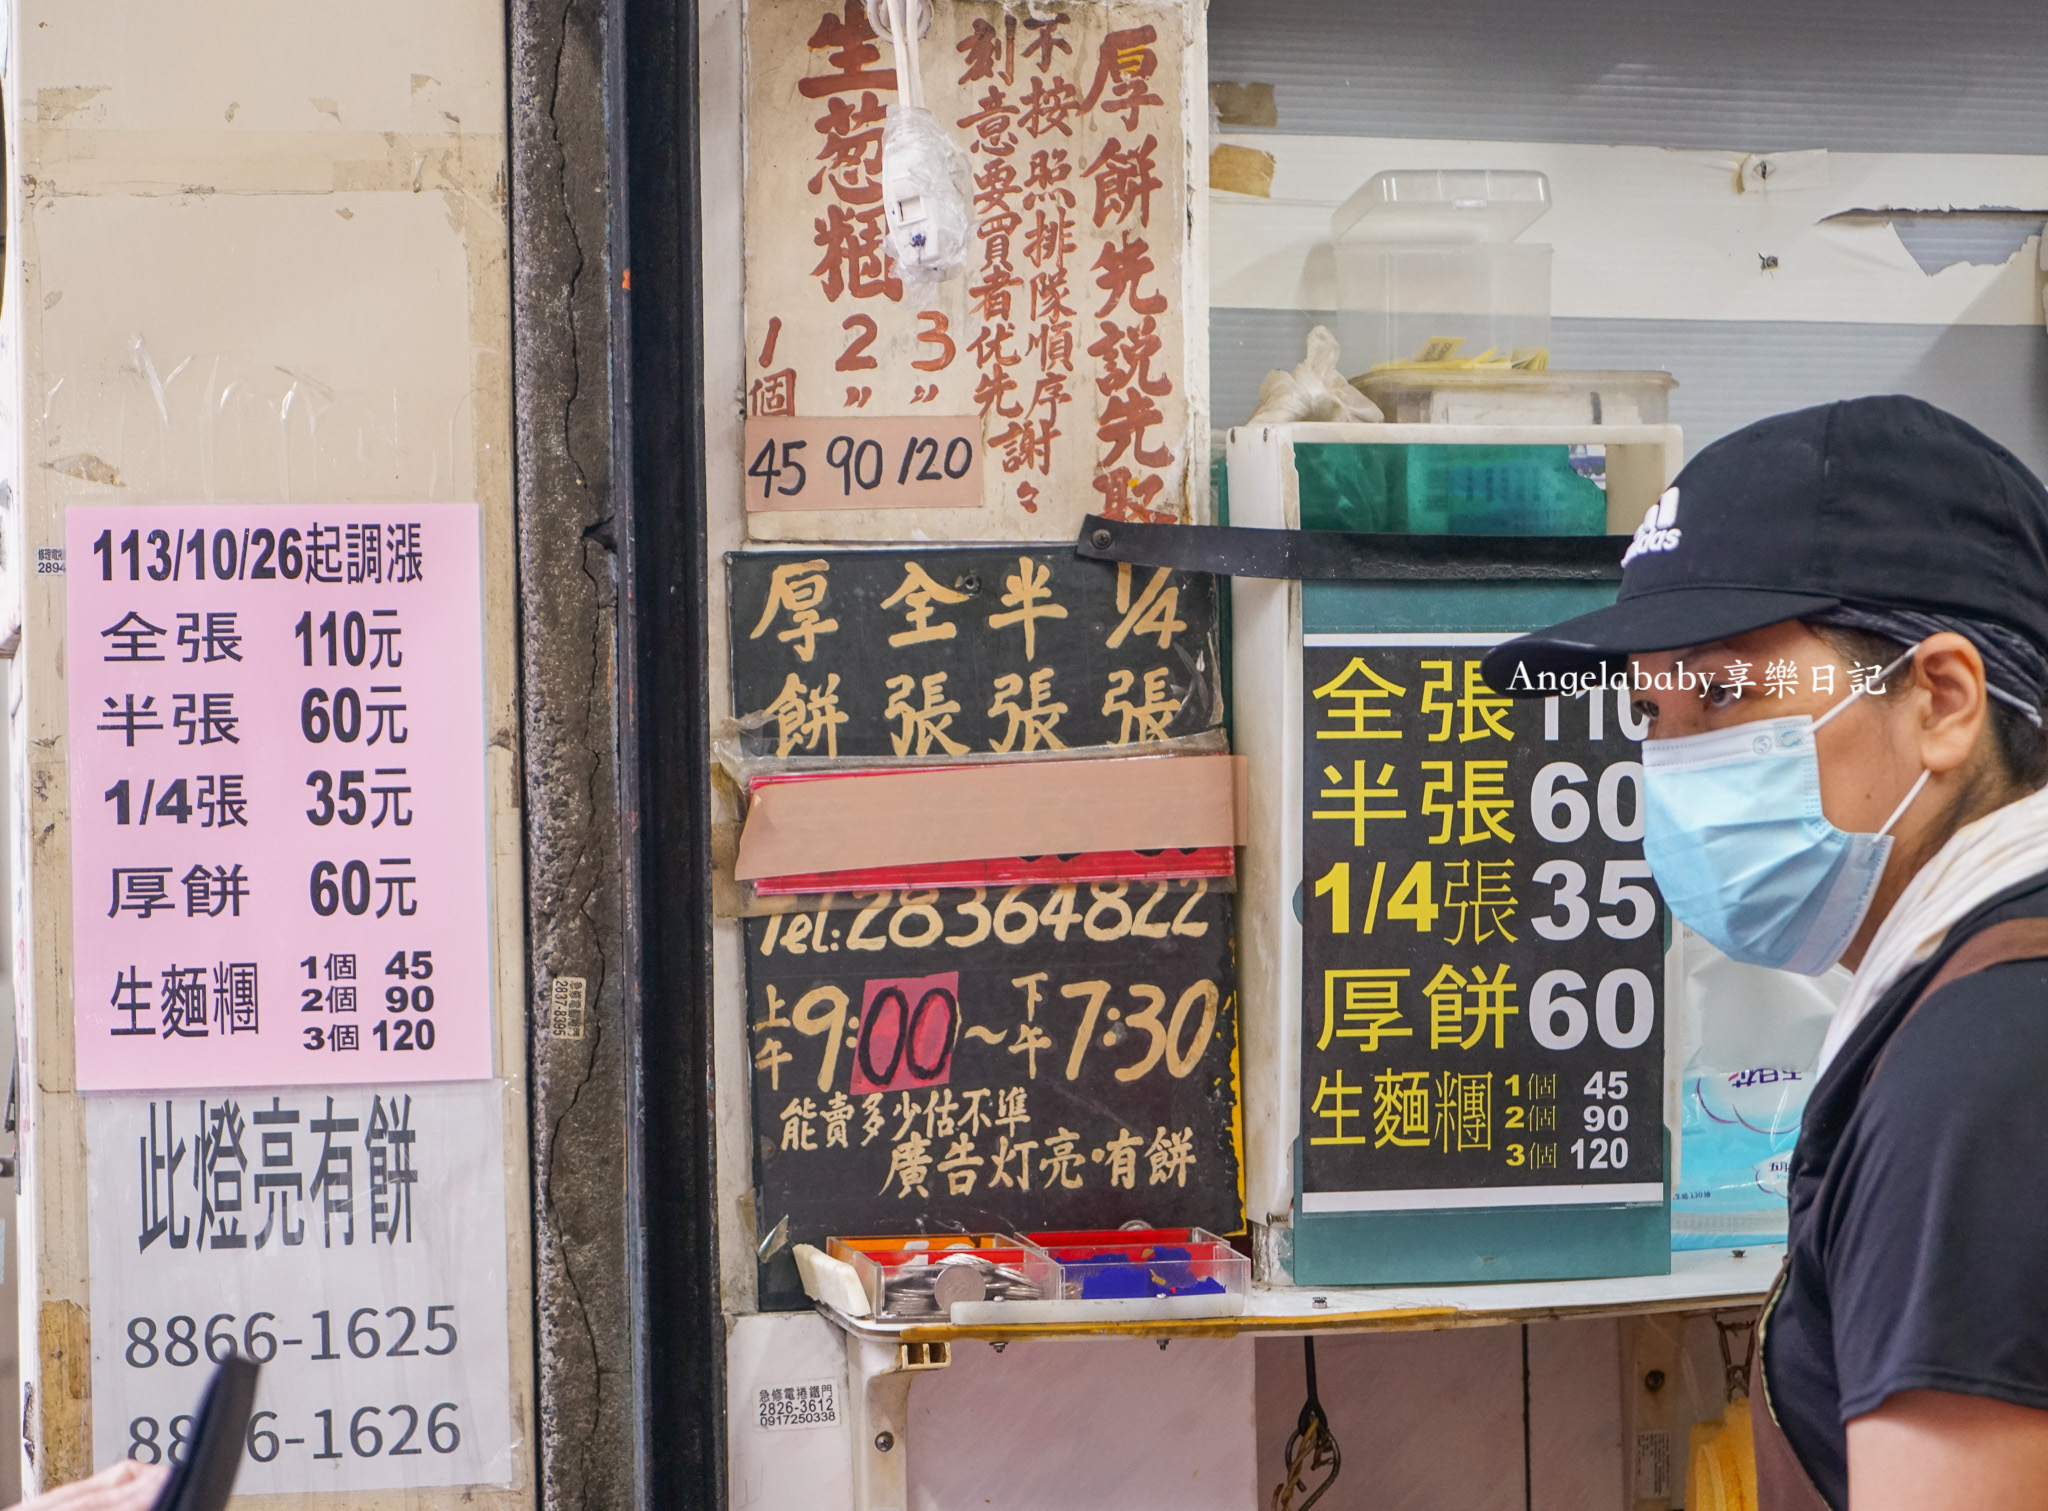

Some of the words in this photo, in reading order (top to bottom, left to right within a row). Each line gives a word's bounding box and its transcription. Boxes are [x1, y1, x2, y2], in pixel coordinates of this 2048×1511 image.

[748, 438, 807, 498] 45
[826, 436, 883, 495] 90
[897, 437, 972, 485] 120
[93, 521, 423, 585] 113/10/26起調漲
[101, 611, 244, 663] 全張
[295, 609, 402, 670] 110元
[750, 559, 849, 758] 厚餅
[881, 561, 970, 756] 全張
[97, 692, 241, 747] 半張
[301, 685, 408, 746] 60元
[1312, 657, 1515, 743] 全張
[104, 774, 248, 828] 1/4張
[305, 768, 413, 829] 35元
[1312, 760, 1515, 846] 半張
[1531, 761, 1645, 843] 60
[107, 864, 250, 918] 厚餅
[309, 857, 417, 918] 60元
[1313, 858, 1519, 946] 1/4張
[1530, 859, 1656, 941] 35
[300, 953, 357, 981] 1個
[385, 951, 433, 978] 45
[110, 961, 259, 1040] 生麵糰
[301, 985, 358, 1013] 2個
[385, 985, 434, 1012] 90
[553, 981, 568, 1036] 2837-8395
[1316, 963, 1518, 1052] 厚餅
[1528, 968, 1655, 1050] 60
[303, 1023, 360, 1051] 3個
[373, 1019, 435, 1051] 120
[1310, 1068, 1492, 1153] 生麵糰
[1504, 1105, 1556, 1132] 2個
[1583, 1104, 1629, 1133] 90
[1504, 1073, 1556, 1100] 1個
[1583, 1070, 1628, 1100] 45
[779, 1087, 1031, 1151] 能賣多少估不準
[138, 1093, 418, 1254] 此燈亮有餅
[1506, 1142, 1557, 1170] 3個
[1570, 1138, 1629, 1170] 120
[125, 1305, 458, 1368] 8866-1625
[759, 1384, 833, 1402] 急修電捲鐵門
[760, 1398, 833, 1416] 2826-3612
[760, 1411, 836, 1426] 0917250338
[128, 1402, 460, 1465] 886-1626
